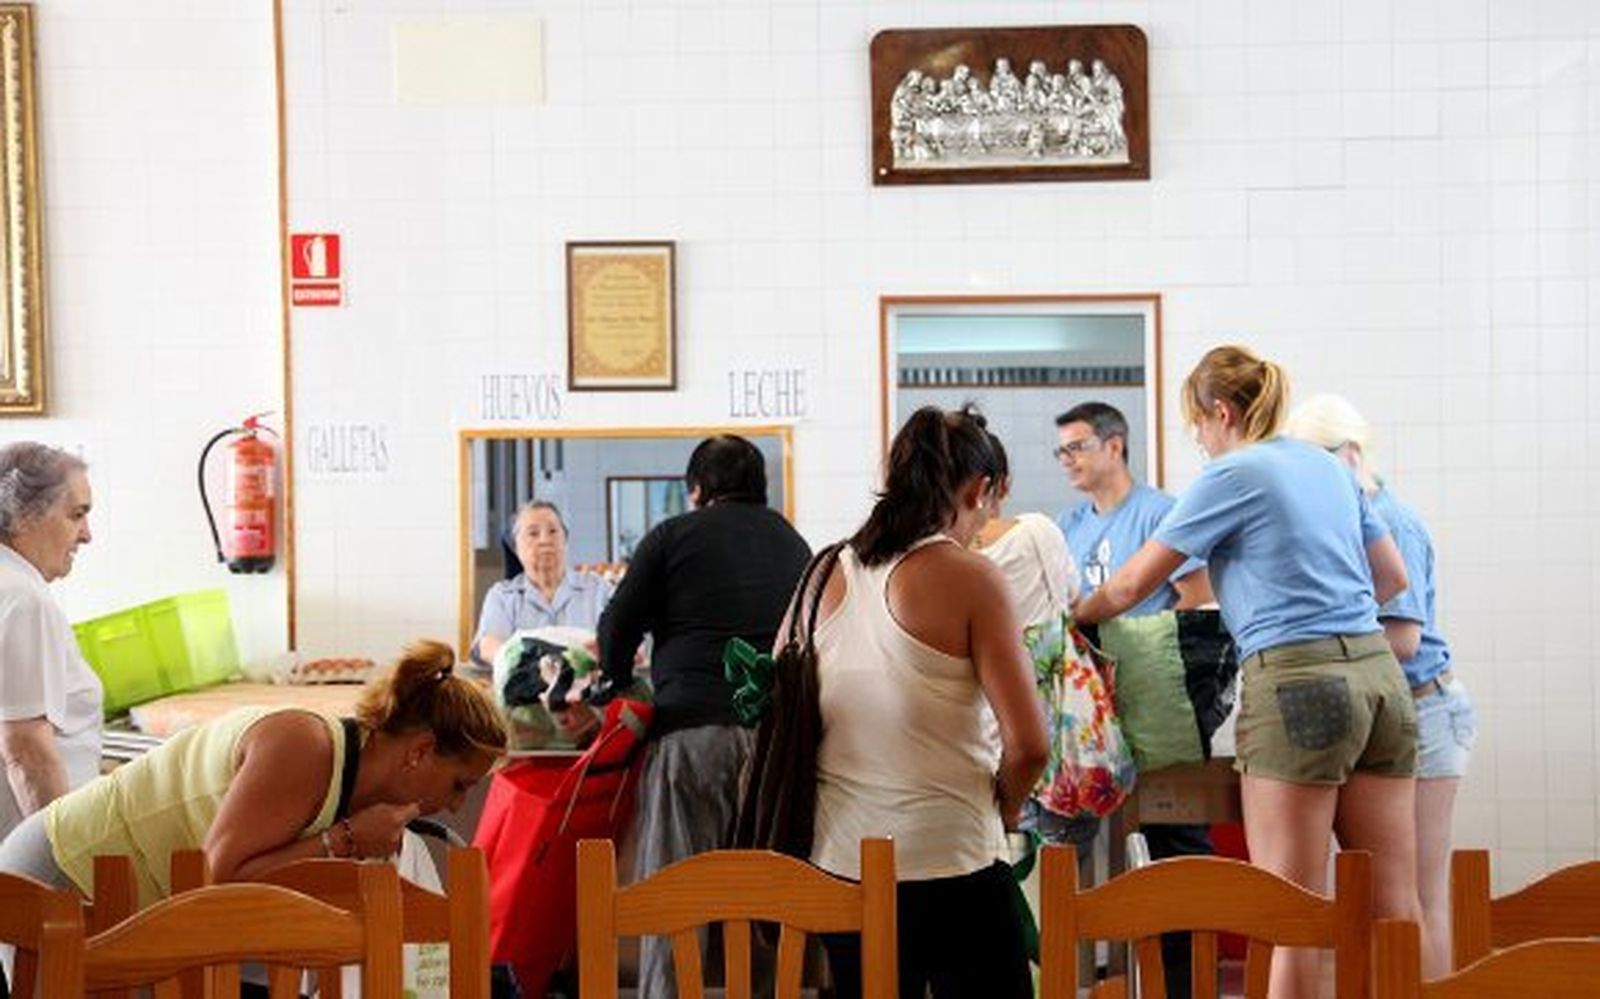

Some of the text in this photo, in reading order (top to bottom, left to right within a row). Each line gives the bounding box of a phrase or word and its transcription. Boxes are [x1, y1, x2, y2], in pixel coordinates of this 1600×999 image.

[481, 374, 562, 420] HUEVOS
[728, 370, 807, 418] LECHE
[307, 425, 390, 473] GALLETAS
